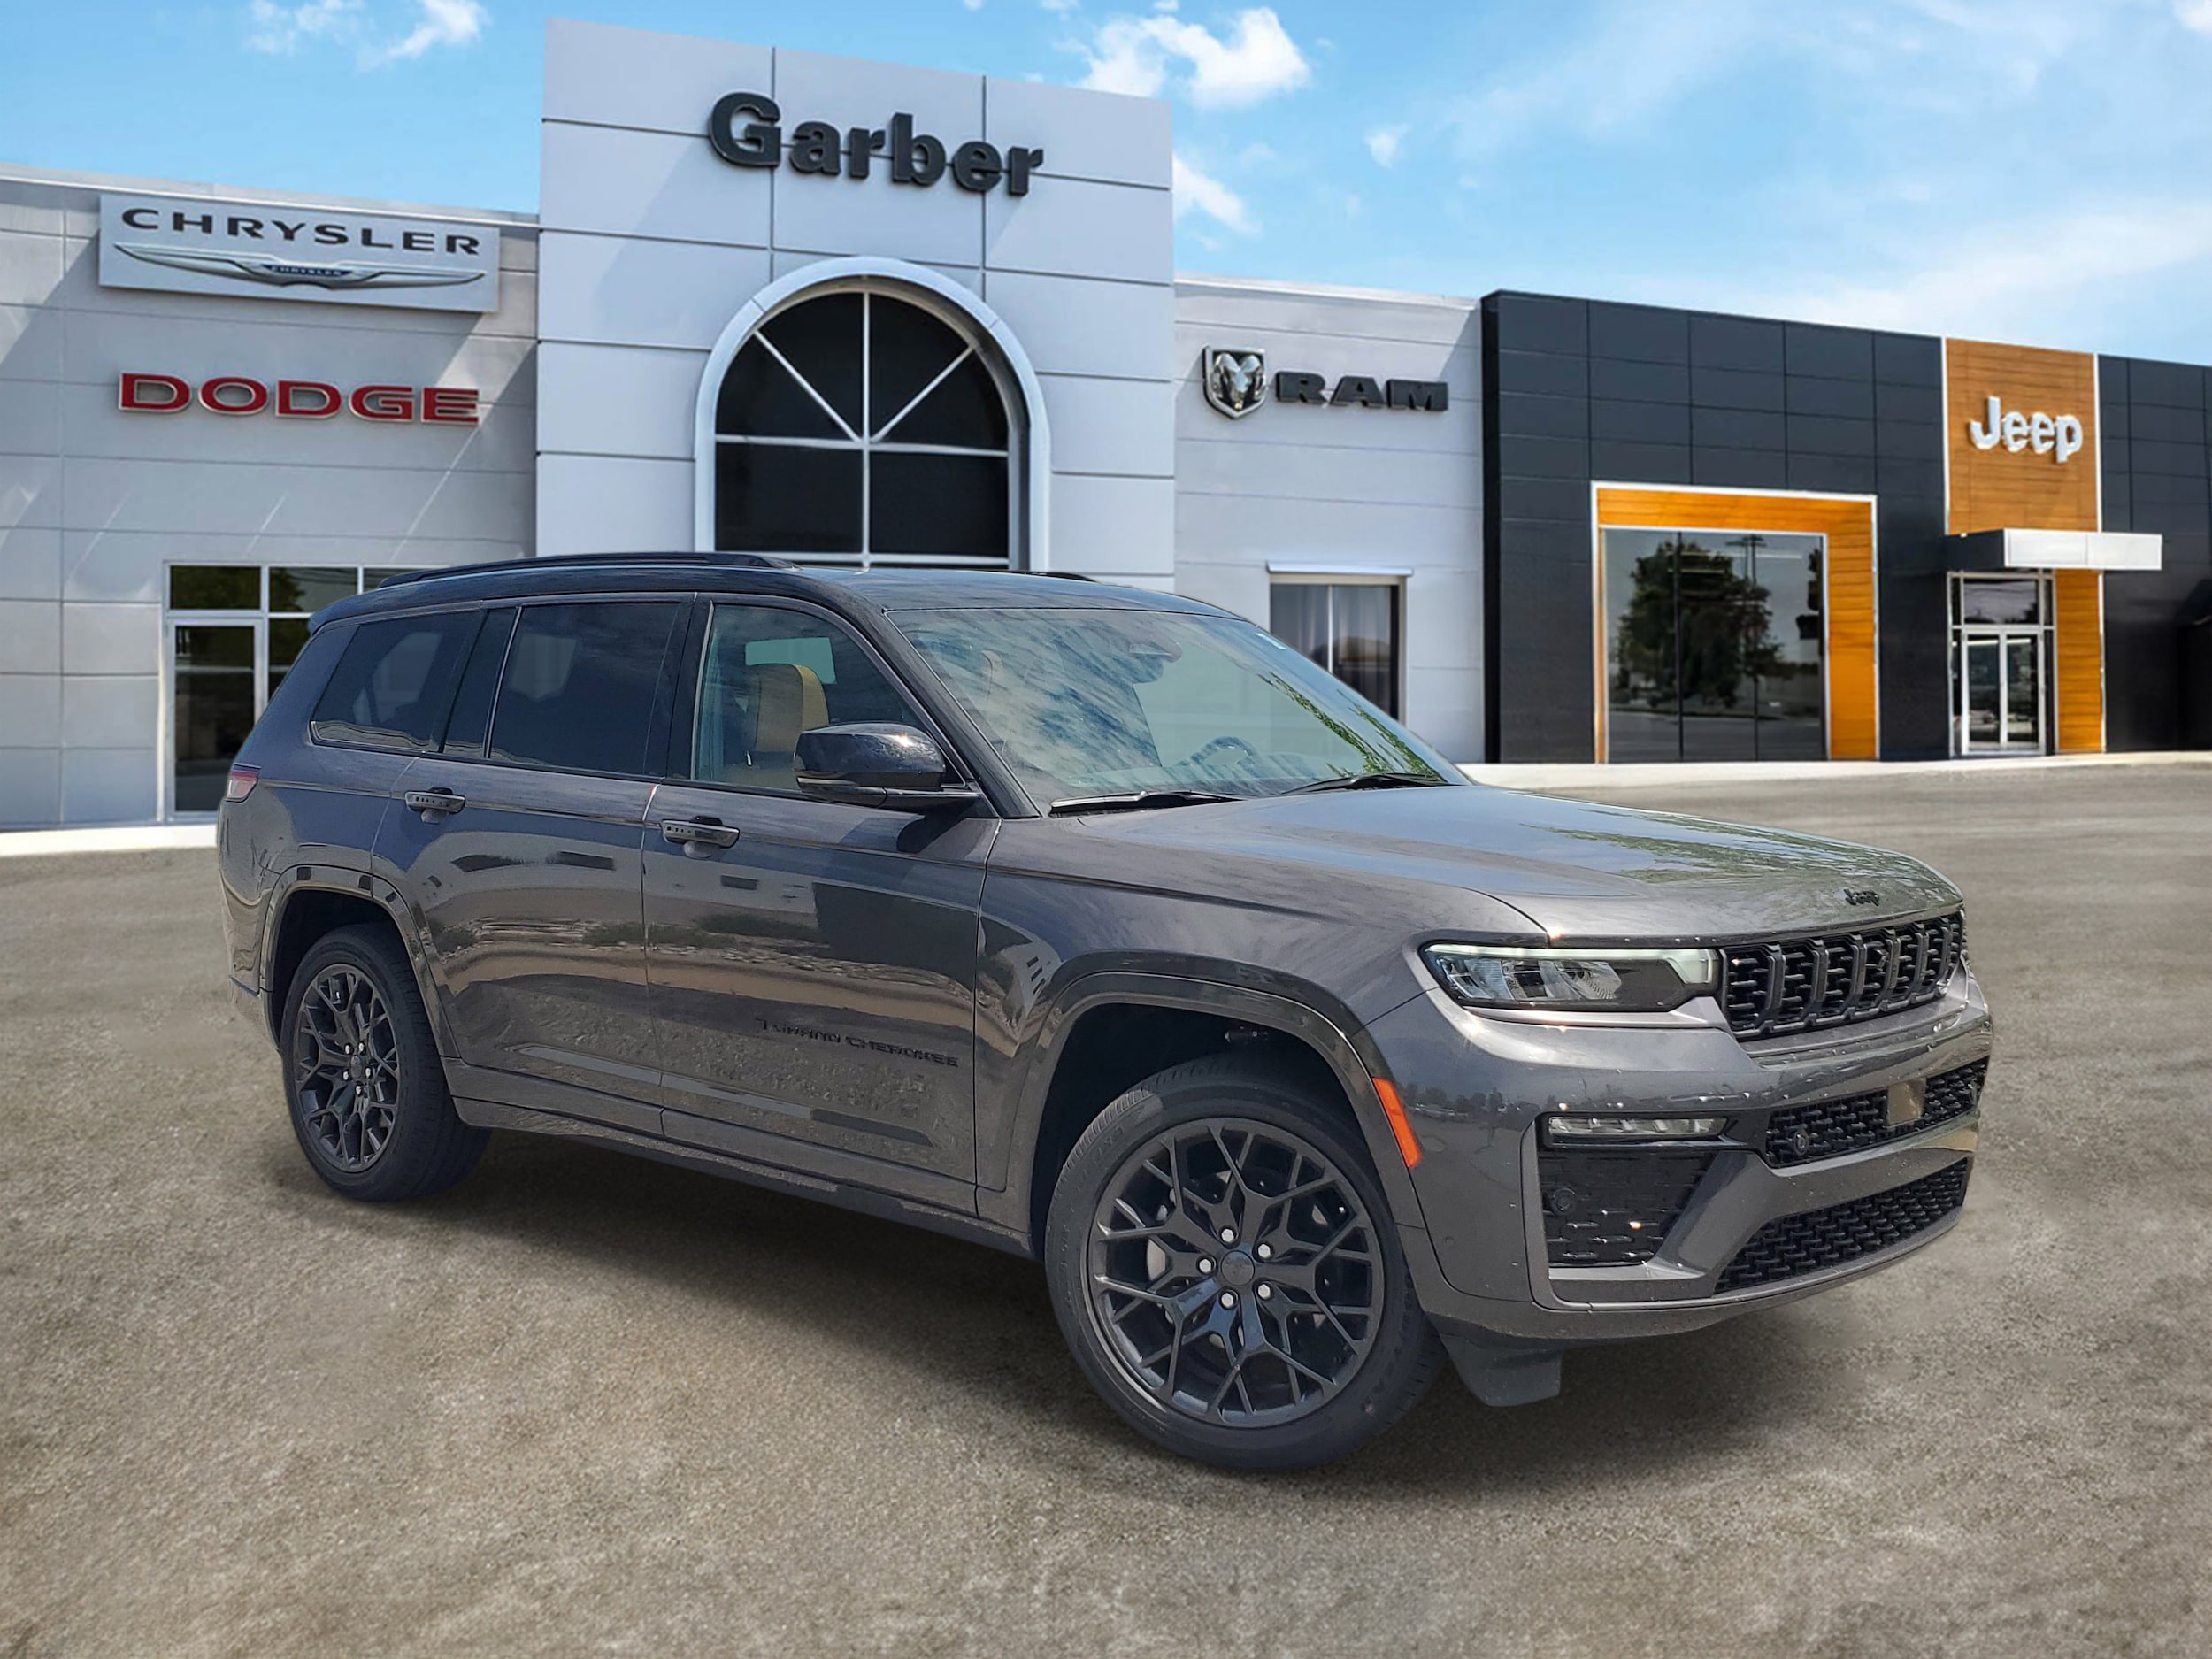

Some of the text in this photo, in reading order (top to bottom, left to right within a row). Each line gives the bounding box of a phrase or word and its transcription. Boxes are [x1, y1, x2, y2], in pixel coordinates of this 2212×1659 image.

[710, 92, 1044, 196] Garber
[121, 208, 480, 256] CHRYSLER
[119, 373, 480, 425] DODGE
[1275, 370, 1448, 411] RAM
[1970, 396, 2083, 464] Jeep
[1843, 888, 1880, 907] Jeep
[845, 1036, 959, 1068] CHEROKEE
